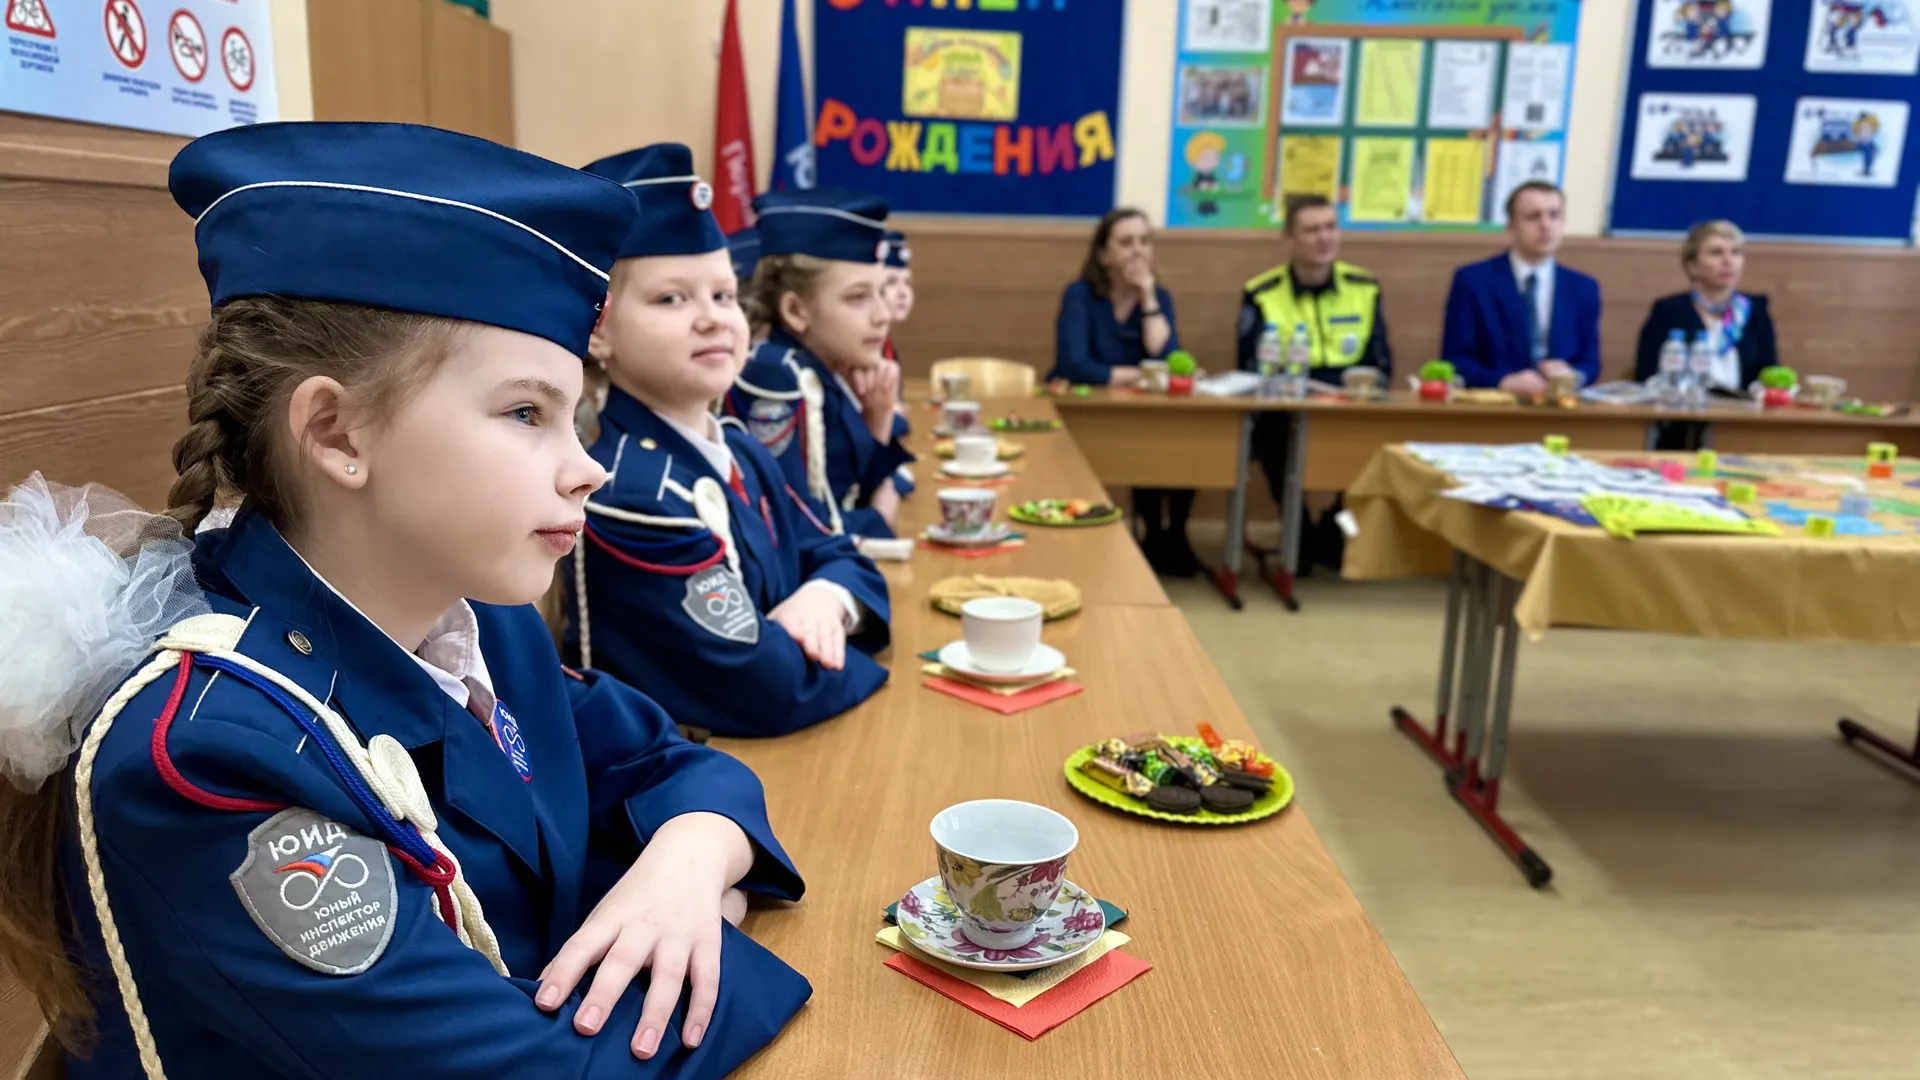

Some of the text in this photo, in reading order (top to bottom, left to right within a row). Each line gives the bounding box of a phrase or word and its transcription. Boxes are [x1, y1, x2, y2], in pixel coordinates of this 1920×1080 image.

[813, 97, 1115, 176] РОЖДЕНИЯ
[267, 821, 348, 861] ЮИД
[300, 901, 381, 943] ИНСПЕКТОР
[314, 891, 362, 920] ЮНЫЙ
[309, 914, 386, 958] ДВИЖЕНИЯ
